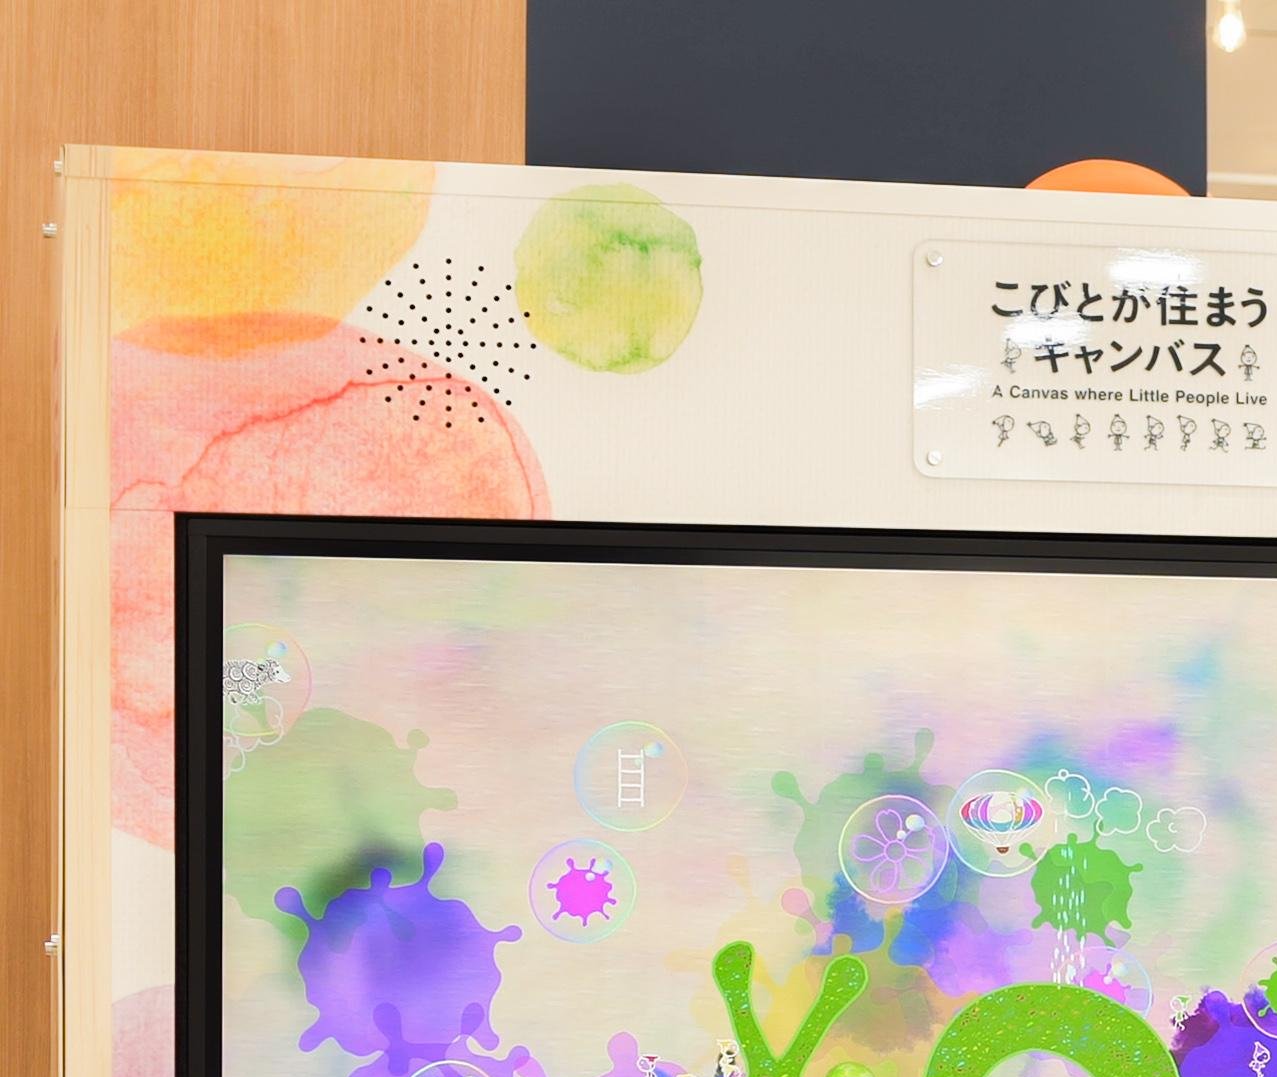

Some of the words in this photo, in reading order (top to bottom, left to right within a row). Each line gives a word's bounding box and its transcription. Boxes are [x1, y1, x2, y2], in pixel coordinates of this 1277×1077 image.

[991, 280, 1267, 328] こびとが住まう
[1035, 339, 1226, 376] キャンバス
[992, 385, 1003, 397] A
[1009, 385, 1068, 400] Canvas
[1075, 388, 1122, 402] where
[1129, 388, 1169, 403] Little
[1175, 390, 1230, 407] People
[1236, 392, 1267, 406] Live
